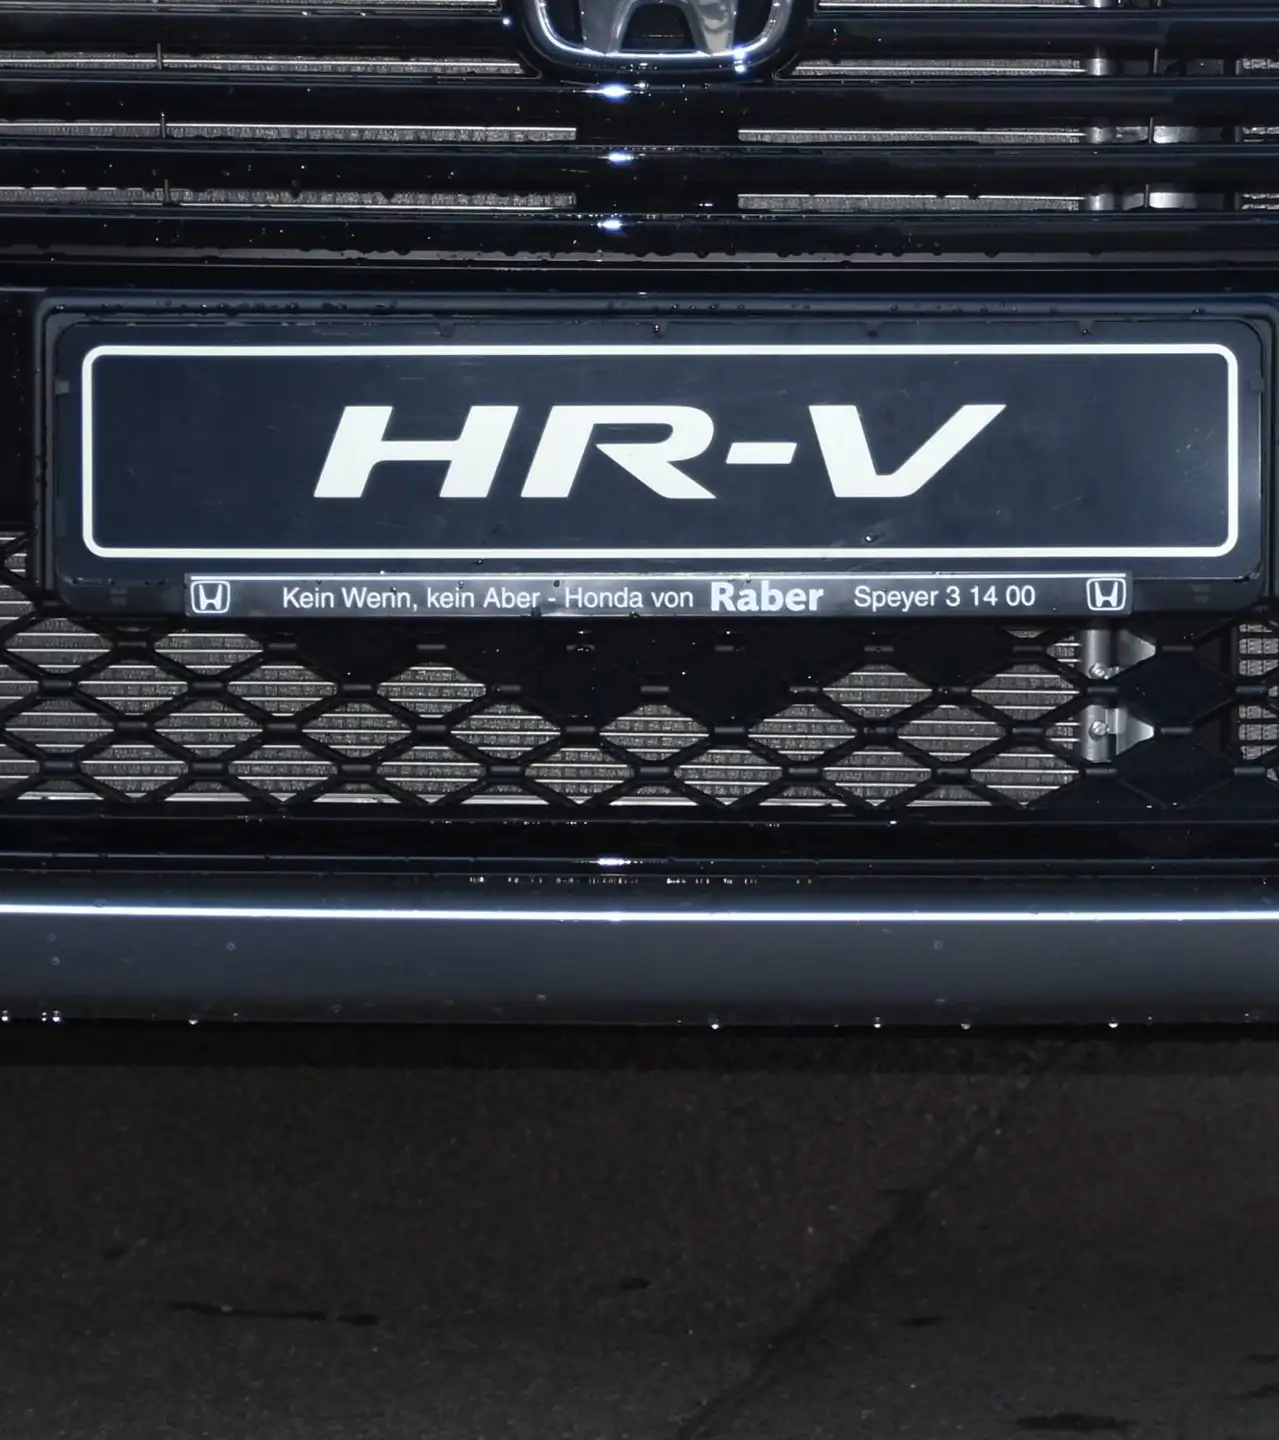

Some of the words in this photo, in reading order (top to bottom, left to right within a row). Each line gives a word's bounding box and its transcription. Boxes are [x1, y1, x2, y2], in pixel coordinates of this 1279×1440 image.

[312, 404, 1007, 499] HR-V
[283, 586, 335, 609] Kein
[341, 586, 418, 613] Wenn,
[426, 585, 475, 609] kein
[483, 585, 540, 609] Aber
[564, 585, 643, 609] Honda
[650, 590, 694, 609] von
[710, 580, 824, 612] Raber
[853, 584, 939, 613] Speyer
[945, 585, 961, 607] 3
[970, 585, 999, 607] 14
[1005, 584, 1036, 607] 00
